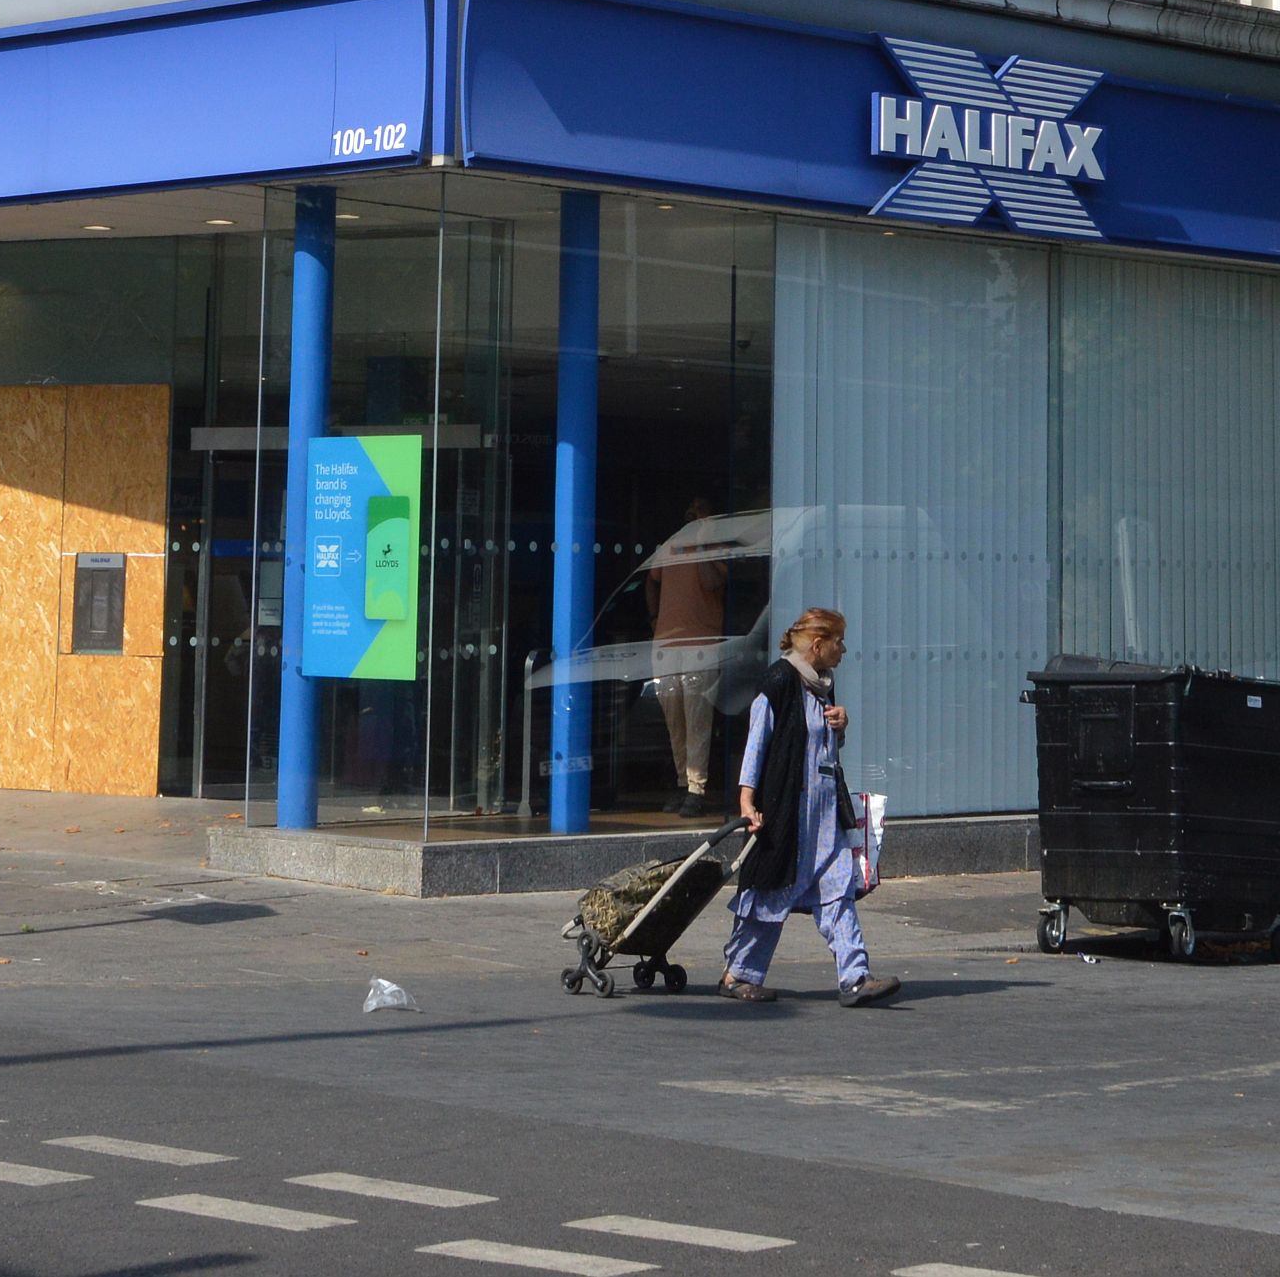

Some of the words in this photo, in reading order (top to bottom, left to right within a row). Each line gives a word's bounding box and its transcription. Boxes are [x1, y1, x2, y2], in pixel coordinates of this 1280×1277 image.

[333, 123, 407, 156] 100-102
[880, 96, 1106, 181] HALIFAX
[315, 464, 330, 475] The
[331, 464, 358, 476] Halifax
[316, 478, 339, 490] brand
[340, 479, 347, 490] is
[315, 492, 351, 507] changing
[315, 508, 323, 520] to
[324, 508, 352, 522] Lloyds.
[316, 553, 339, 561] HALIFAX
[375, 560, 399, 568] LLOYDS
